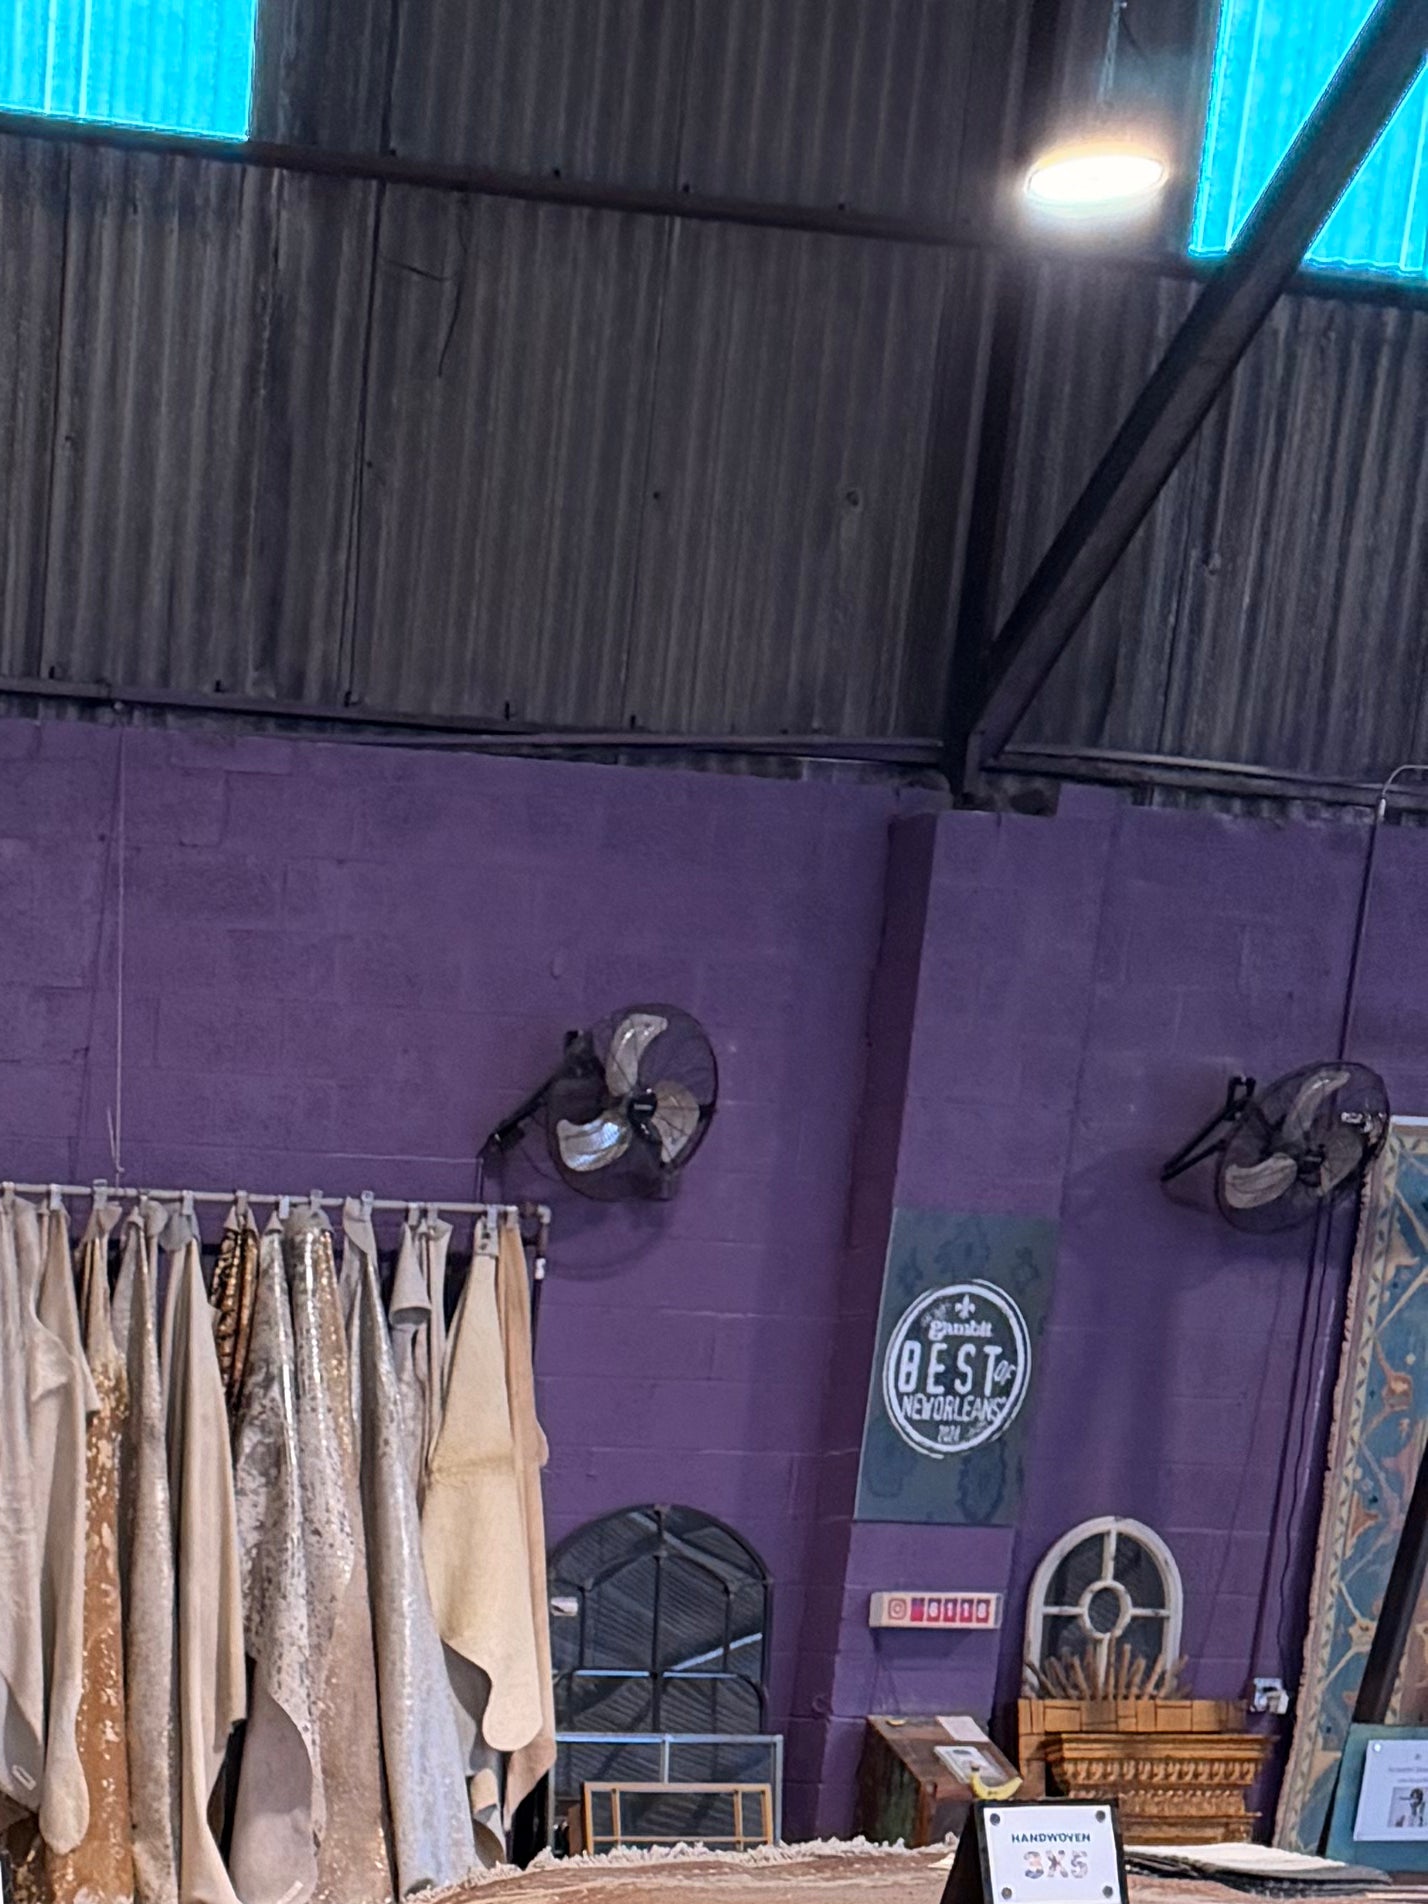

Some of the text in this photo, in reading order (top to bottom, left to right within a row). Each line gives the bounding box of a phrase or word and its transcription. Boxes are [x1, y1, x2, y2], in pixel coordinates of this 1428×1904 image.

[898, 1340, 1017, 1396] BEST OF
[1011, 1833, 1092, 1843] HANDWOVEN
[1023, 1850, 1089, 1879] 3X5
